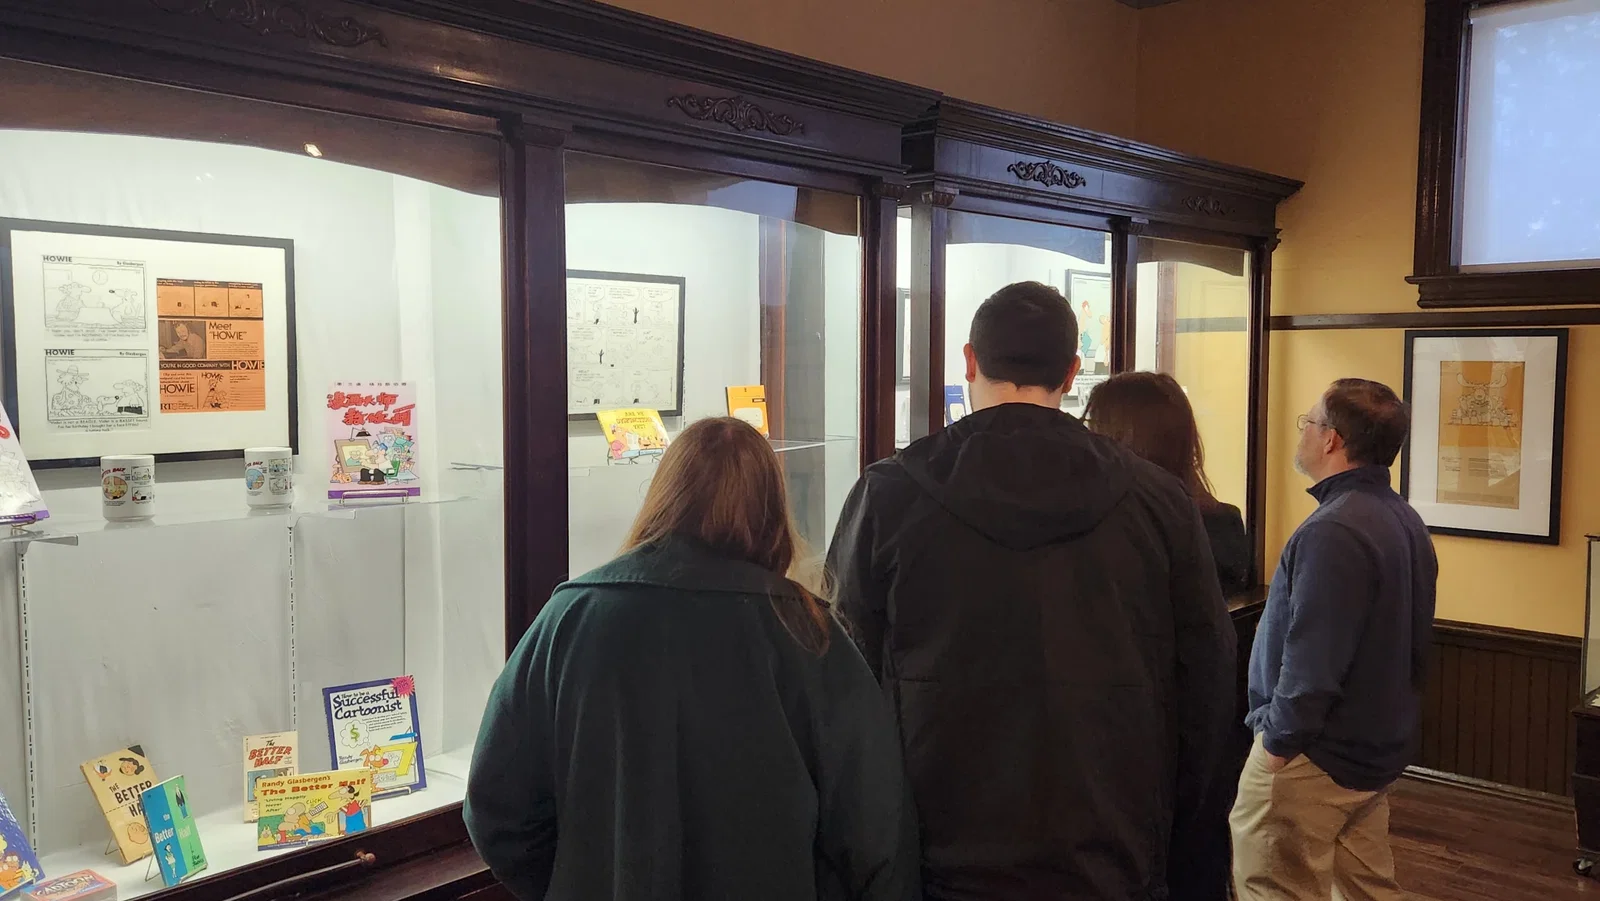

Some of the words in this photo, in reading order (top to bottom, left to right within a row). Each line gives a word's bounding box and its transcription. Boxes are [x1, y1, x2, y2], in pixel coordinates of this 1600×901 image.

[209, 321, 232, 330] Meet
[209, 331, 247, 340] "HOWIE"
[232, 360, 265, 370] HOWIE
[202, 372, 224, 381] HOWIE
[160, 384, 195, 394] HOWIE
[332, 686, 399, 709] Successful
[335, 700, 402, 720] Cartoonist
[248, 746, 292, 760] BETTER
[254, 755, 283, 768] HALF
[109, 782, 120, 792] THE
[262, 780, 284, 788] Randy
[287, 775, 330, 785] Glasbergen's
[291, 783, 333, 792] Better
[339, 778, 366, 787] Half
[115, 780, 152, 804] BETTER
[128, 802, 144, 817] HA
[154, 828, 174, 844] Better
